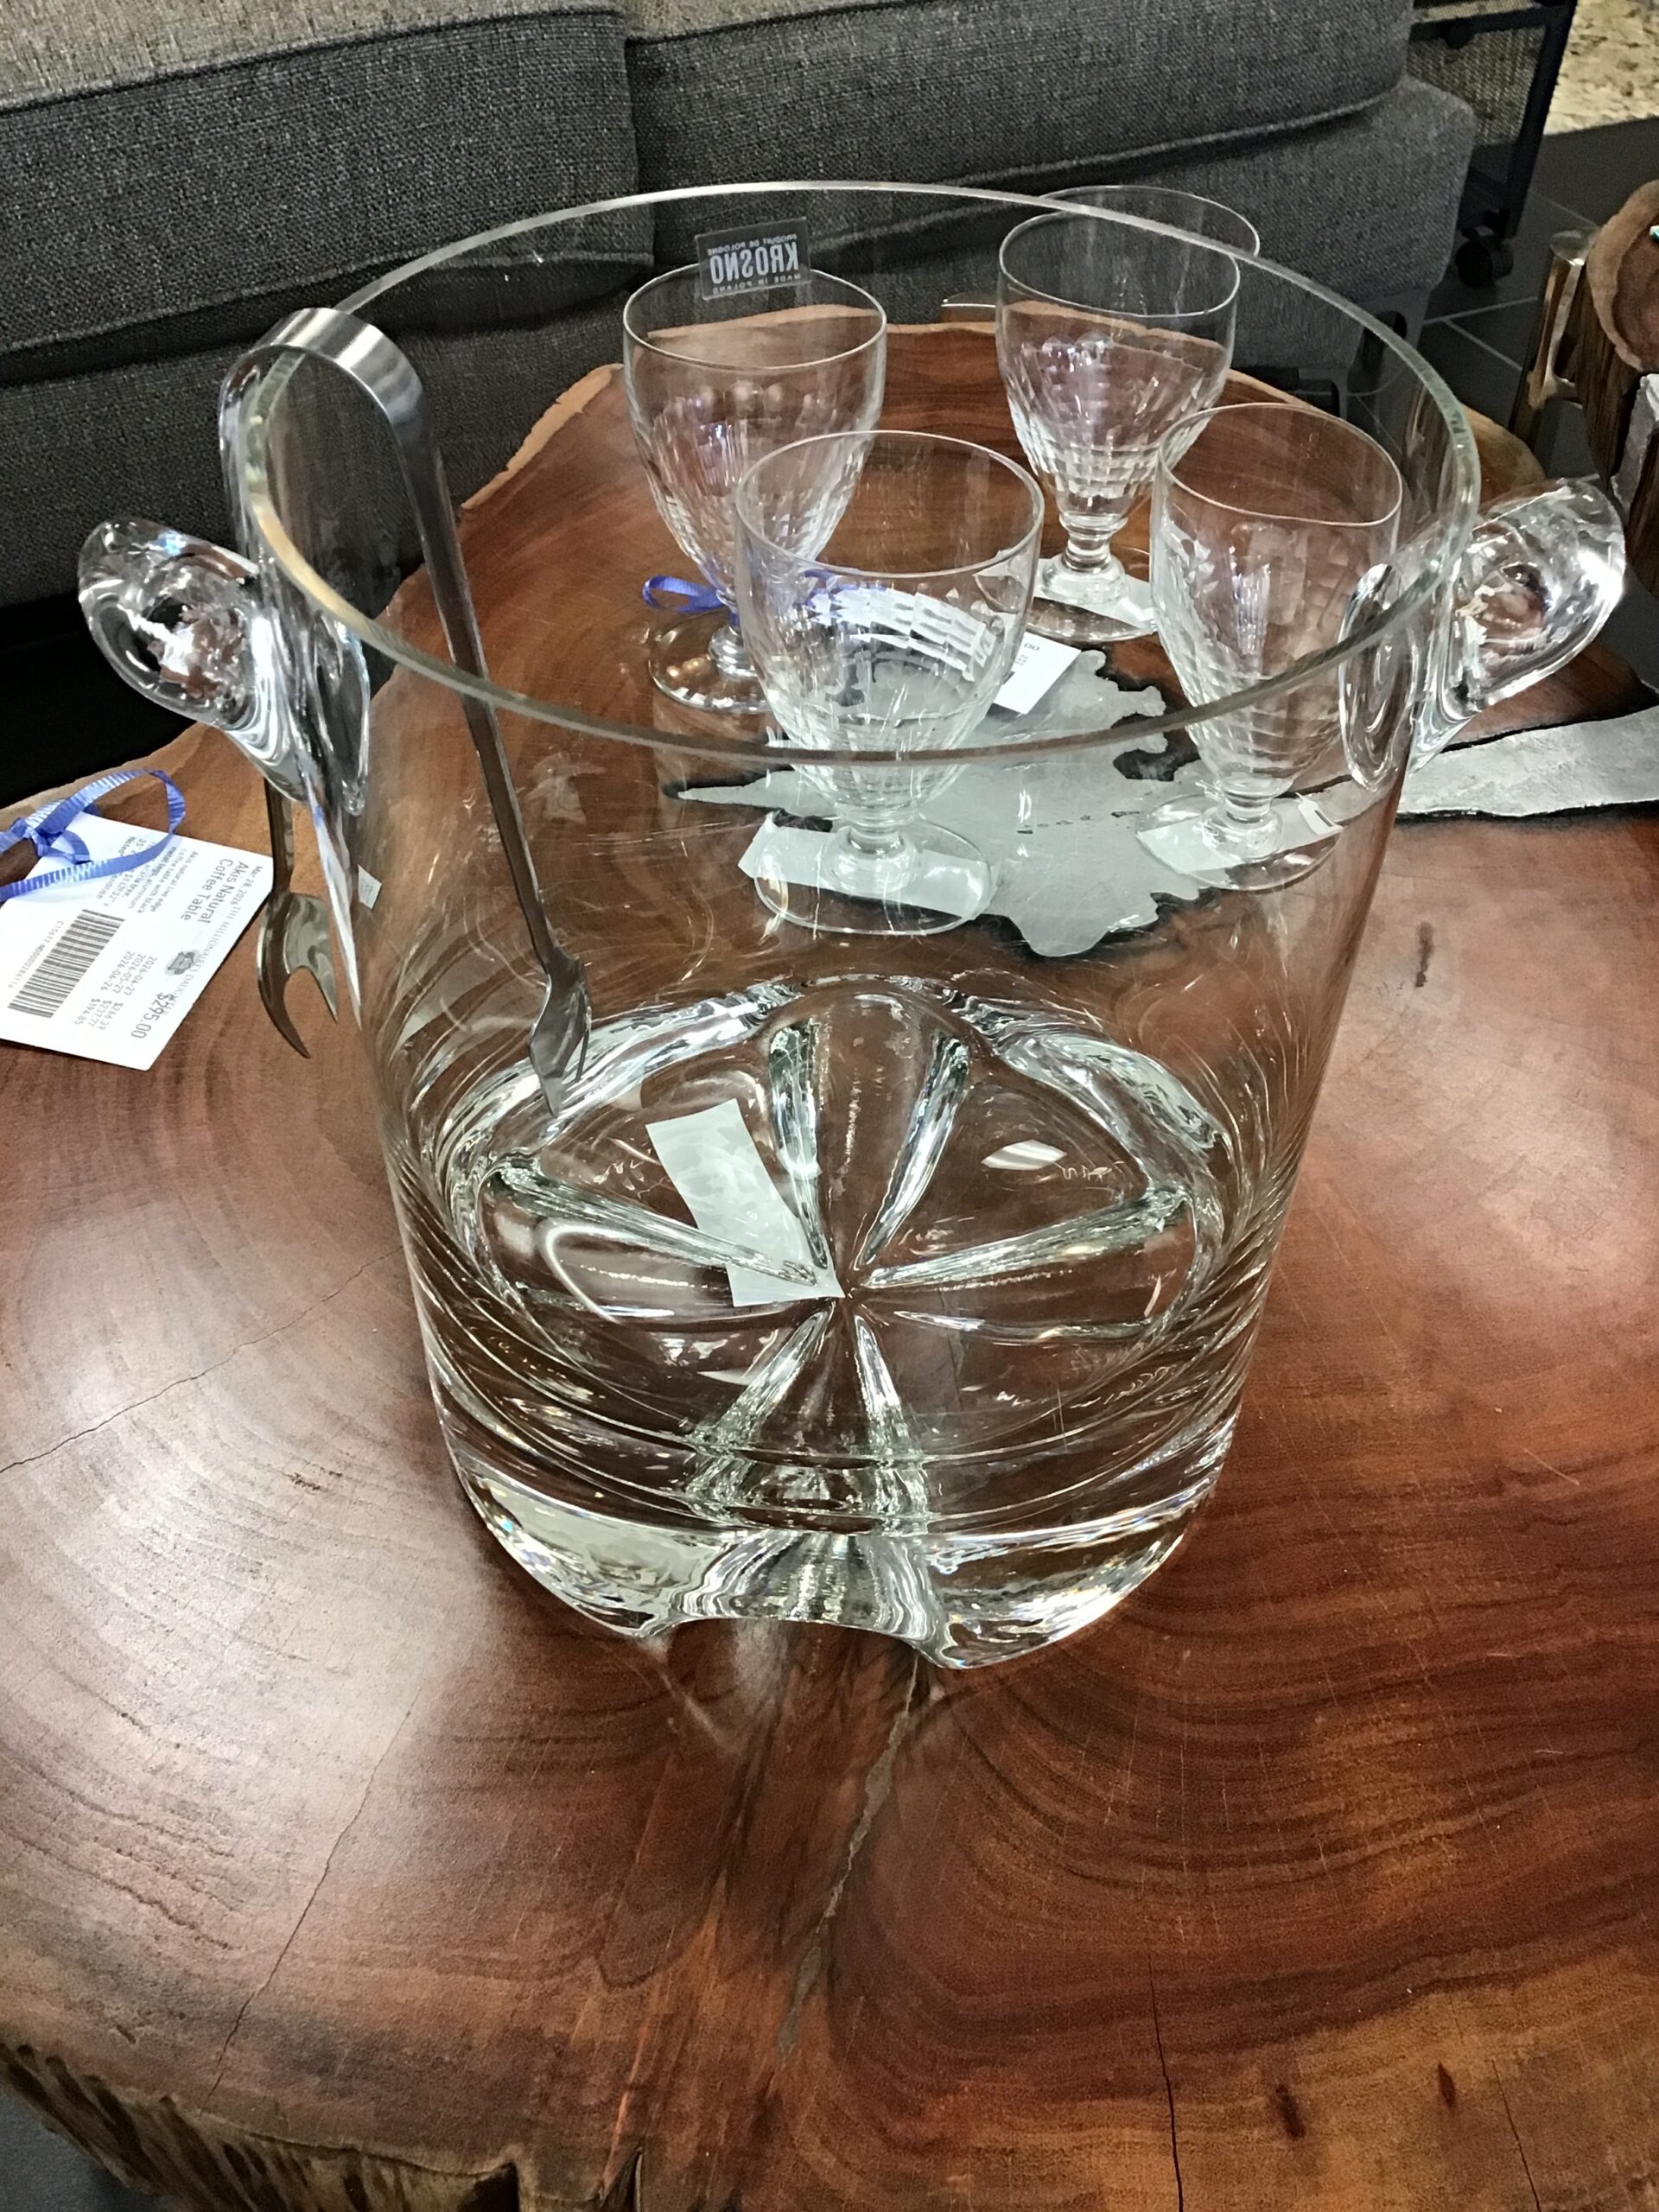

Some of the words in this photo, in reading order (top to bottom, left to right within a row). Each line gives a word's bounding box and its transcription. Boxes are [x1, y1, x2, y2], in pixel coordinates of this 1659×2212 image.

[202, 859, 234, 891] Coffee
[226, 861, 250, 883] Akis
[181, 893, 211, 921] Table
[200, 884, 235, 924] Natural
[130, 991, 176, 1039] $295.00
